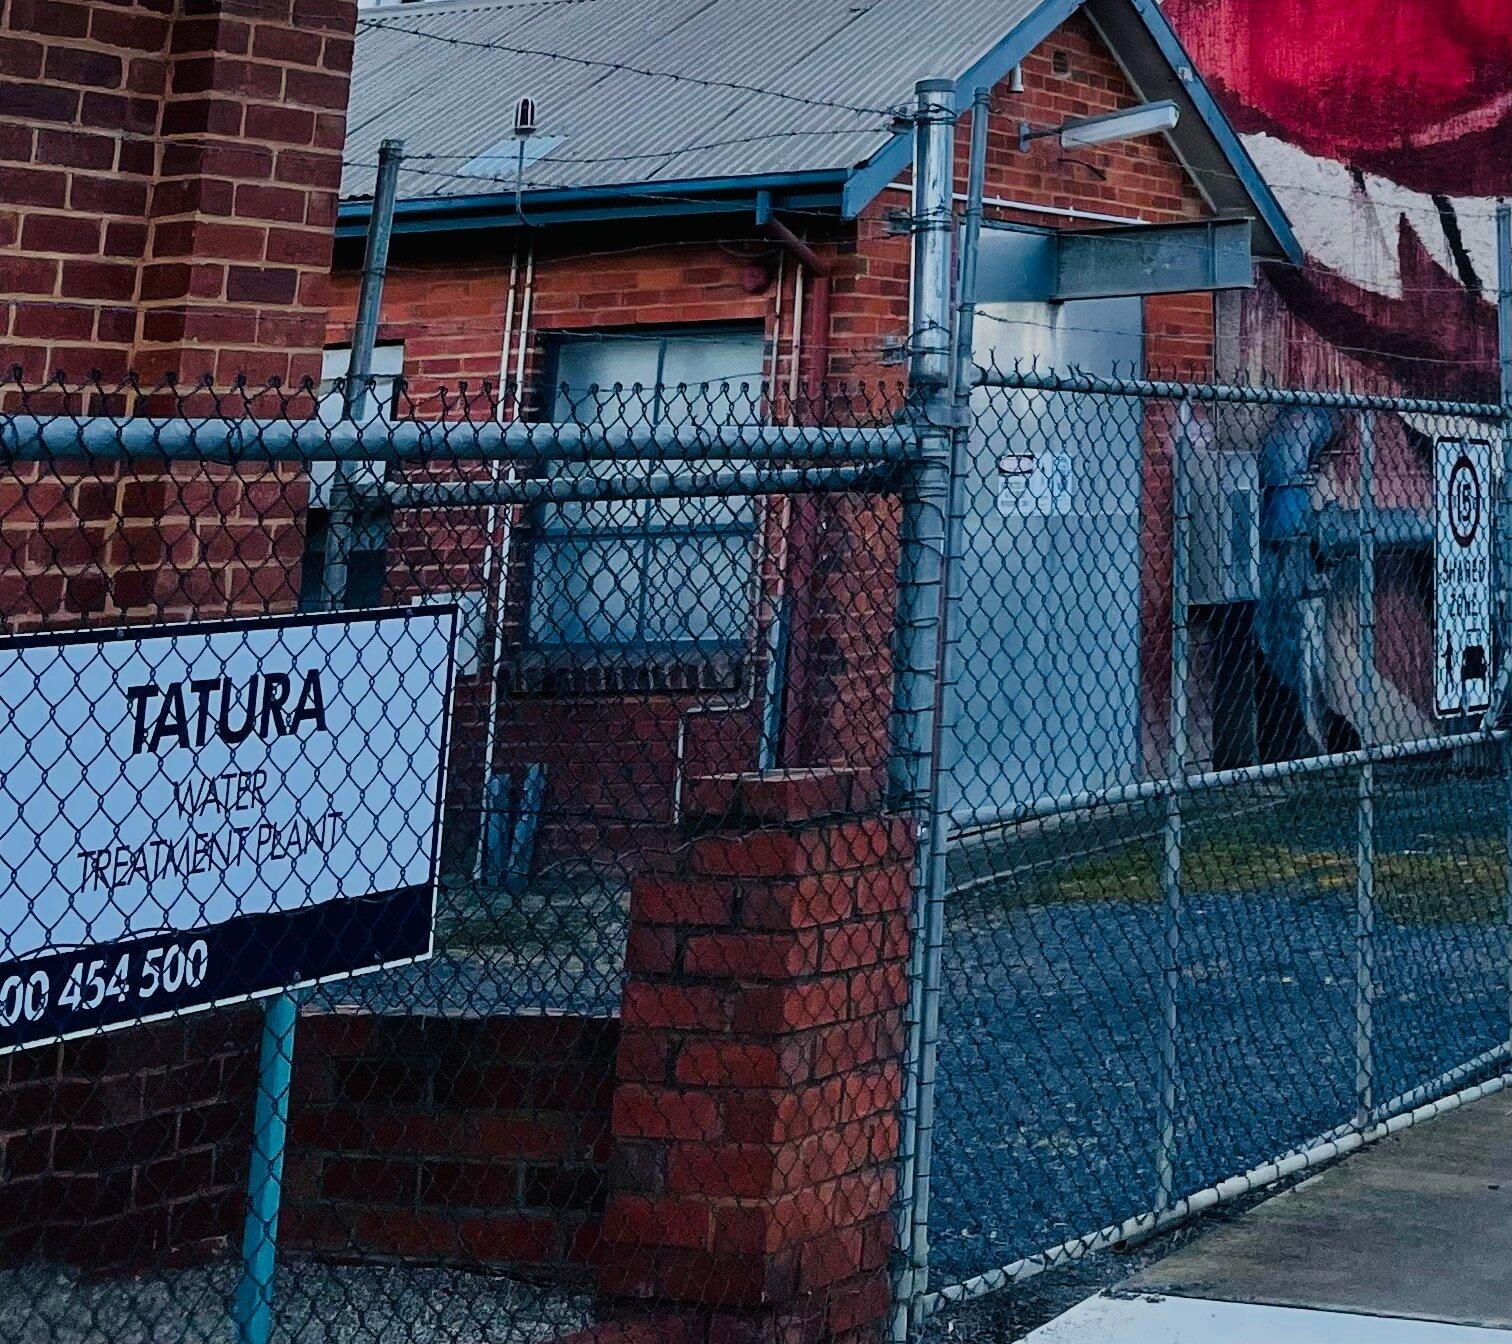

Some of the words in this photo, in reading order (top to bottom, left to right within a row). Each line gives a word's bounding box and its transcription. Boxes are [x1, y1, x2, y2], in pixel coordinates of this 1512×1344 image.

[1457, 483, 1472, 522] 15
[127, 668, 328, 755] TATURA
[174, 769, 268, 819] WATER
[77, 826, 253, 894] TREATMENT
[256, 811, 344, 865] PLANT
[57, 953, 130, 1012] 454
[139, 939, 209, 998] 500
